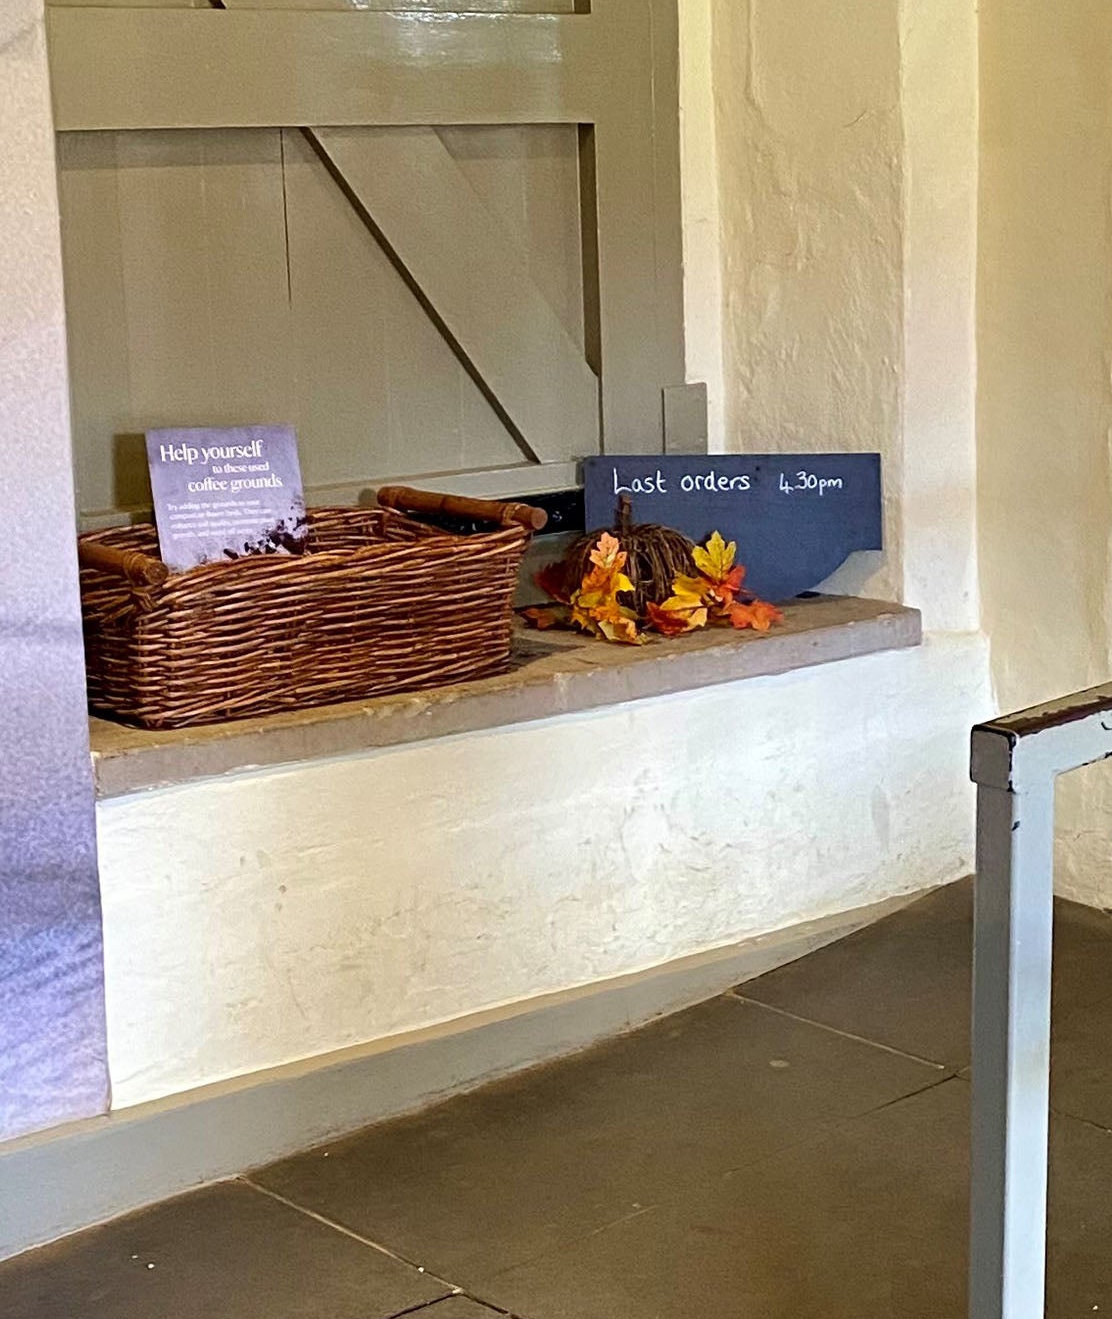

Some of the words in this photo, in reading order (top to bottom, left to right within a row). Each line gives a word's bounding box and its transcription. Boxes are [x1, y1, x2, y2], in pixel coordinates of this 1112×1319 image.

[160, 443, 199, 465] Help
[200, 439, 264, 465] yourself
[212, 465, 222, 474] to
[223, 463, 248, 474] these
[248, 461, 270, 473] used
[187, 477, 228, 493] coffee
[229, 473, 284, 493] grounds
[612, 466, 668, 494] Last
[680, 470, 751, 494] orders
